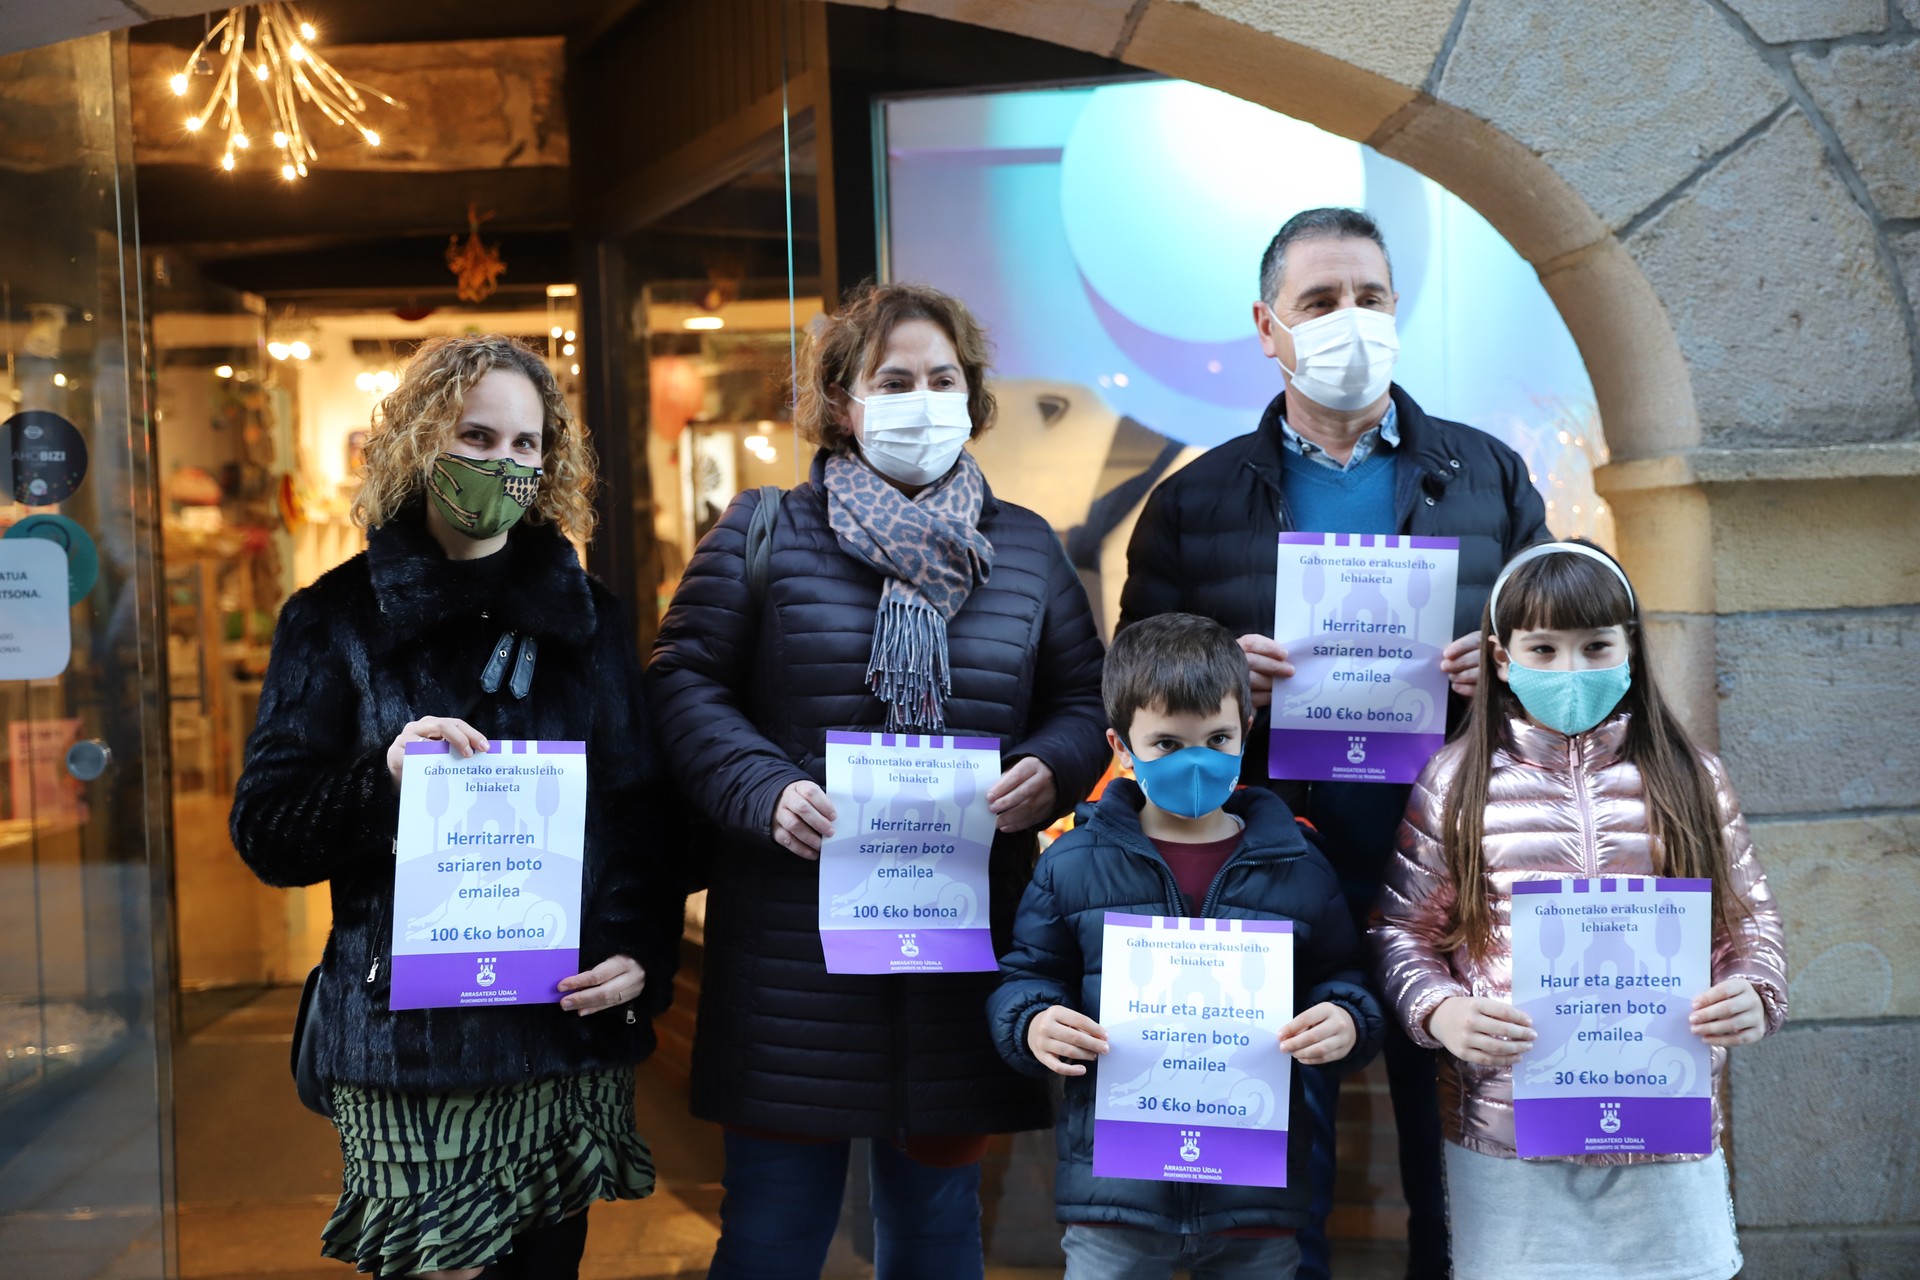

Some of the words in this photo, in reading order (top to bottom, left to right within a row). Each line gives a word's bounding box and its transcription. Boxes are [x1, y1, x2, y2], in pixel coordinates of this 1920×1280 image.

[1299, 555, 1366, 568] Gabonetako
[1369, 557, 1436, 570] erakusleiho
[1340, 573, 1393, 584] lehiaketa
[0, 589, 42, 600] TSONA.
[1322, 619, 1406, 634] Herritarren
[1313, 643, 1373, 657] sariaren
[1378, 645, 1413, 659] boto
[1332, 669, 1391, 683] emailea
[1305, 707, 1332, 720] 100
[1336, 708, 1362, 721] €ko
[1367, 708, 1413, 722] bonoa
[847, 756, 913, 768] Gabonetako
[915, 758, 979, 770] erakusleiho
[424, 765, 493, 776] Gabonetako
[495, 765, 564, 776] erakusleiho
[889, 773, 939, 784] lehiaketa
[465, 781, 520, 792] lehiaketa
[870, 819, 951, 832] Herritarren
[447, 832, 535, 845] Herritarren
[860, 842, 918, 854] sariaren
[922, 841, 955, 854] boto
[437, 859, 501, 872] sariaren
[506, 857, 542, 871] boto
[877, 865, 933, 878] emailea
[458, 885, 520, 898] emailea
[853, 905, 879, 918] 100
[883, 905, 908, 918] €ko
[913, 905, 957, 918] bonoa
[1535, 904, 1608, 917] Gabonetako
[1611, 904, 1686, 916] erakusleiho
[430, 927, 459, 941] 100
[463, 927, 492, 940] €ko
[496, 925, 545, 939] bonoa
[1581, 922, 1638, 933] lehiaketa
[1126, 937, 1196, 950] Gabonetako
[1199, 941, 1270, 953] erakusleiho
[1170, 956, 1225, 967] lehiaketa
[1541, 974, 1579, 988] Haur
[1584, 974, 1610, 987] eta
[1615, 974, 1681, 990] gazteen
[1128, 1000, 1167, 1015] Haur
[1171, 1002, 1197, 1016] eta
[1202, 1003, 1264, 1020] gazteen
[1555, 1001, 1621, 1015] sariaren
[1627, 1001, 1666, 1015] boto
[1141, 1029, 1207, 1044] sariaren
[1212, 1032, 1249, 1046] boto
[1577, 1027, 1643, 1042] emailea
[1163, 1058, 1226, 1072] emailea
[1554, 1071, 1574, 1085] 30
[1579, 1071, 1609, 1085] €ko
[1614, 1070, 1667, 1085] bonoa
[1137, 1096, 1157, 1110] 30
[1161, 1098, 1191, 1112] €ko
[1196, 1099, 1247, 1116] bonoa
